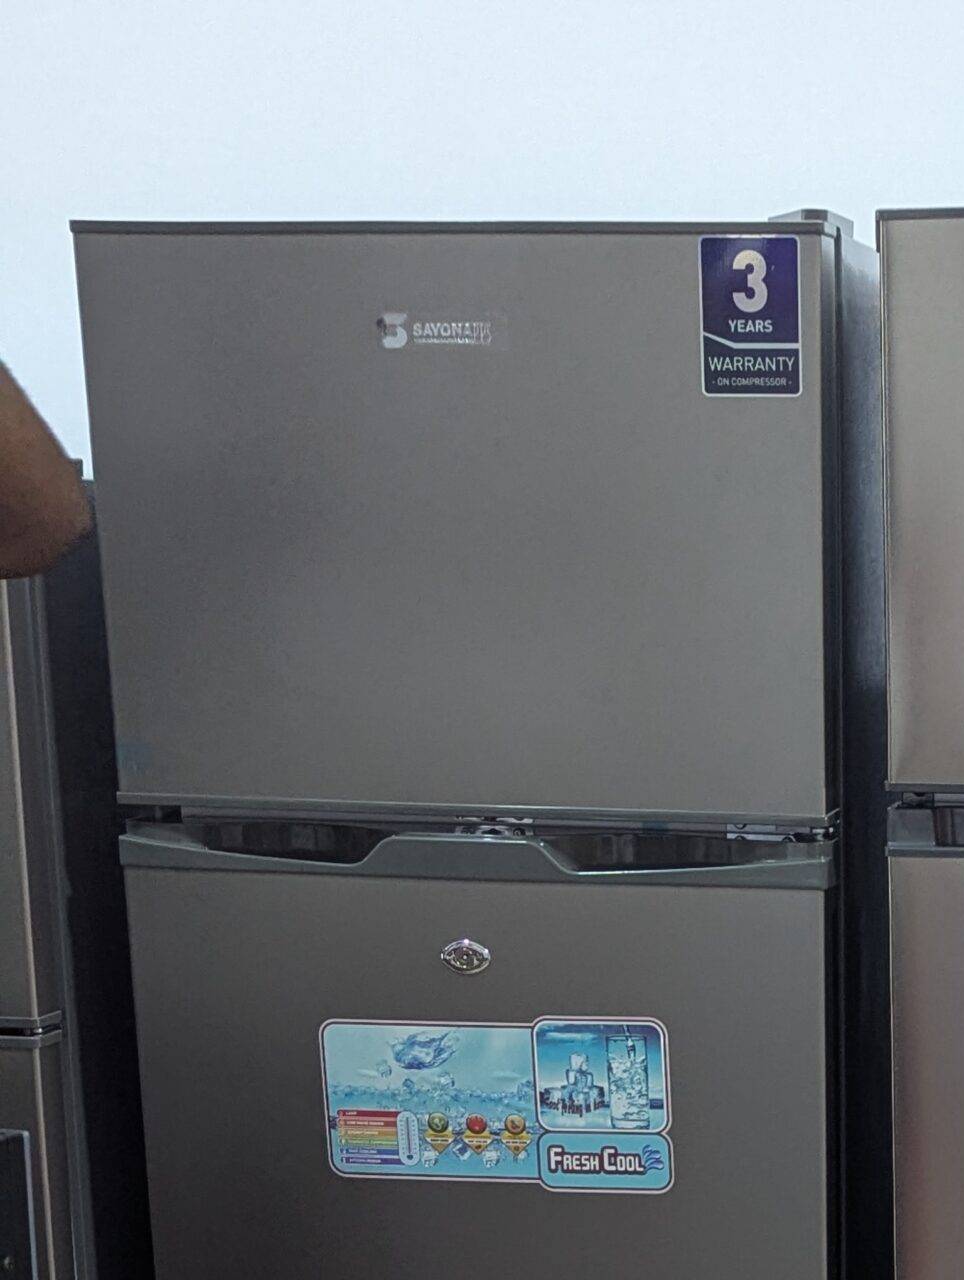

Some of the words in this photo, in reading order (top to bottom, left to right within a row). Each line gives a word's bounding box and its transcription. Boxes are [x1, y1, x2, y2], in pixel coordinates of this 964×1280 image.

[732, 250, 768, 313] 3
[729, 320, 773, 333] YEARS
[708, 356, 796, 372] WARRANTY
[717, 377, 730, 386] ON
[731, 377, 787, 386] COMPRESSOR
[549, 1147, 600, 1171] FRESH
[603, 1149, 645, 1172] COOL
